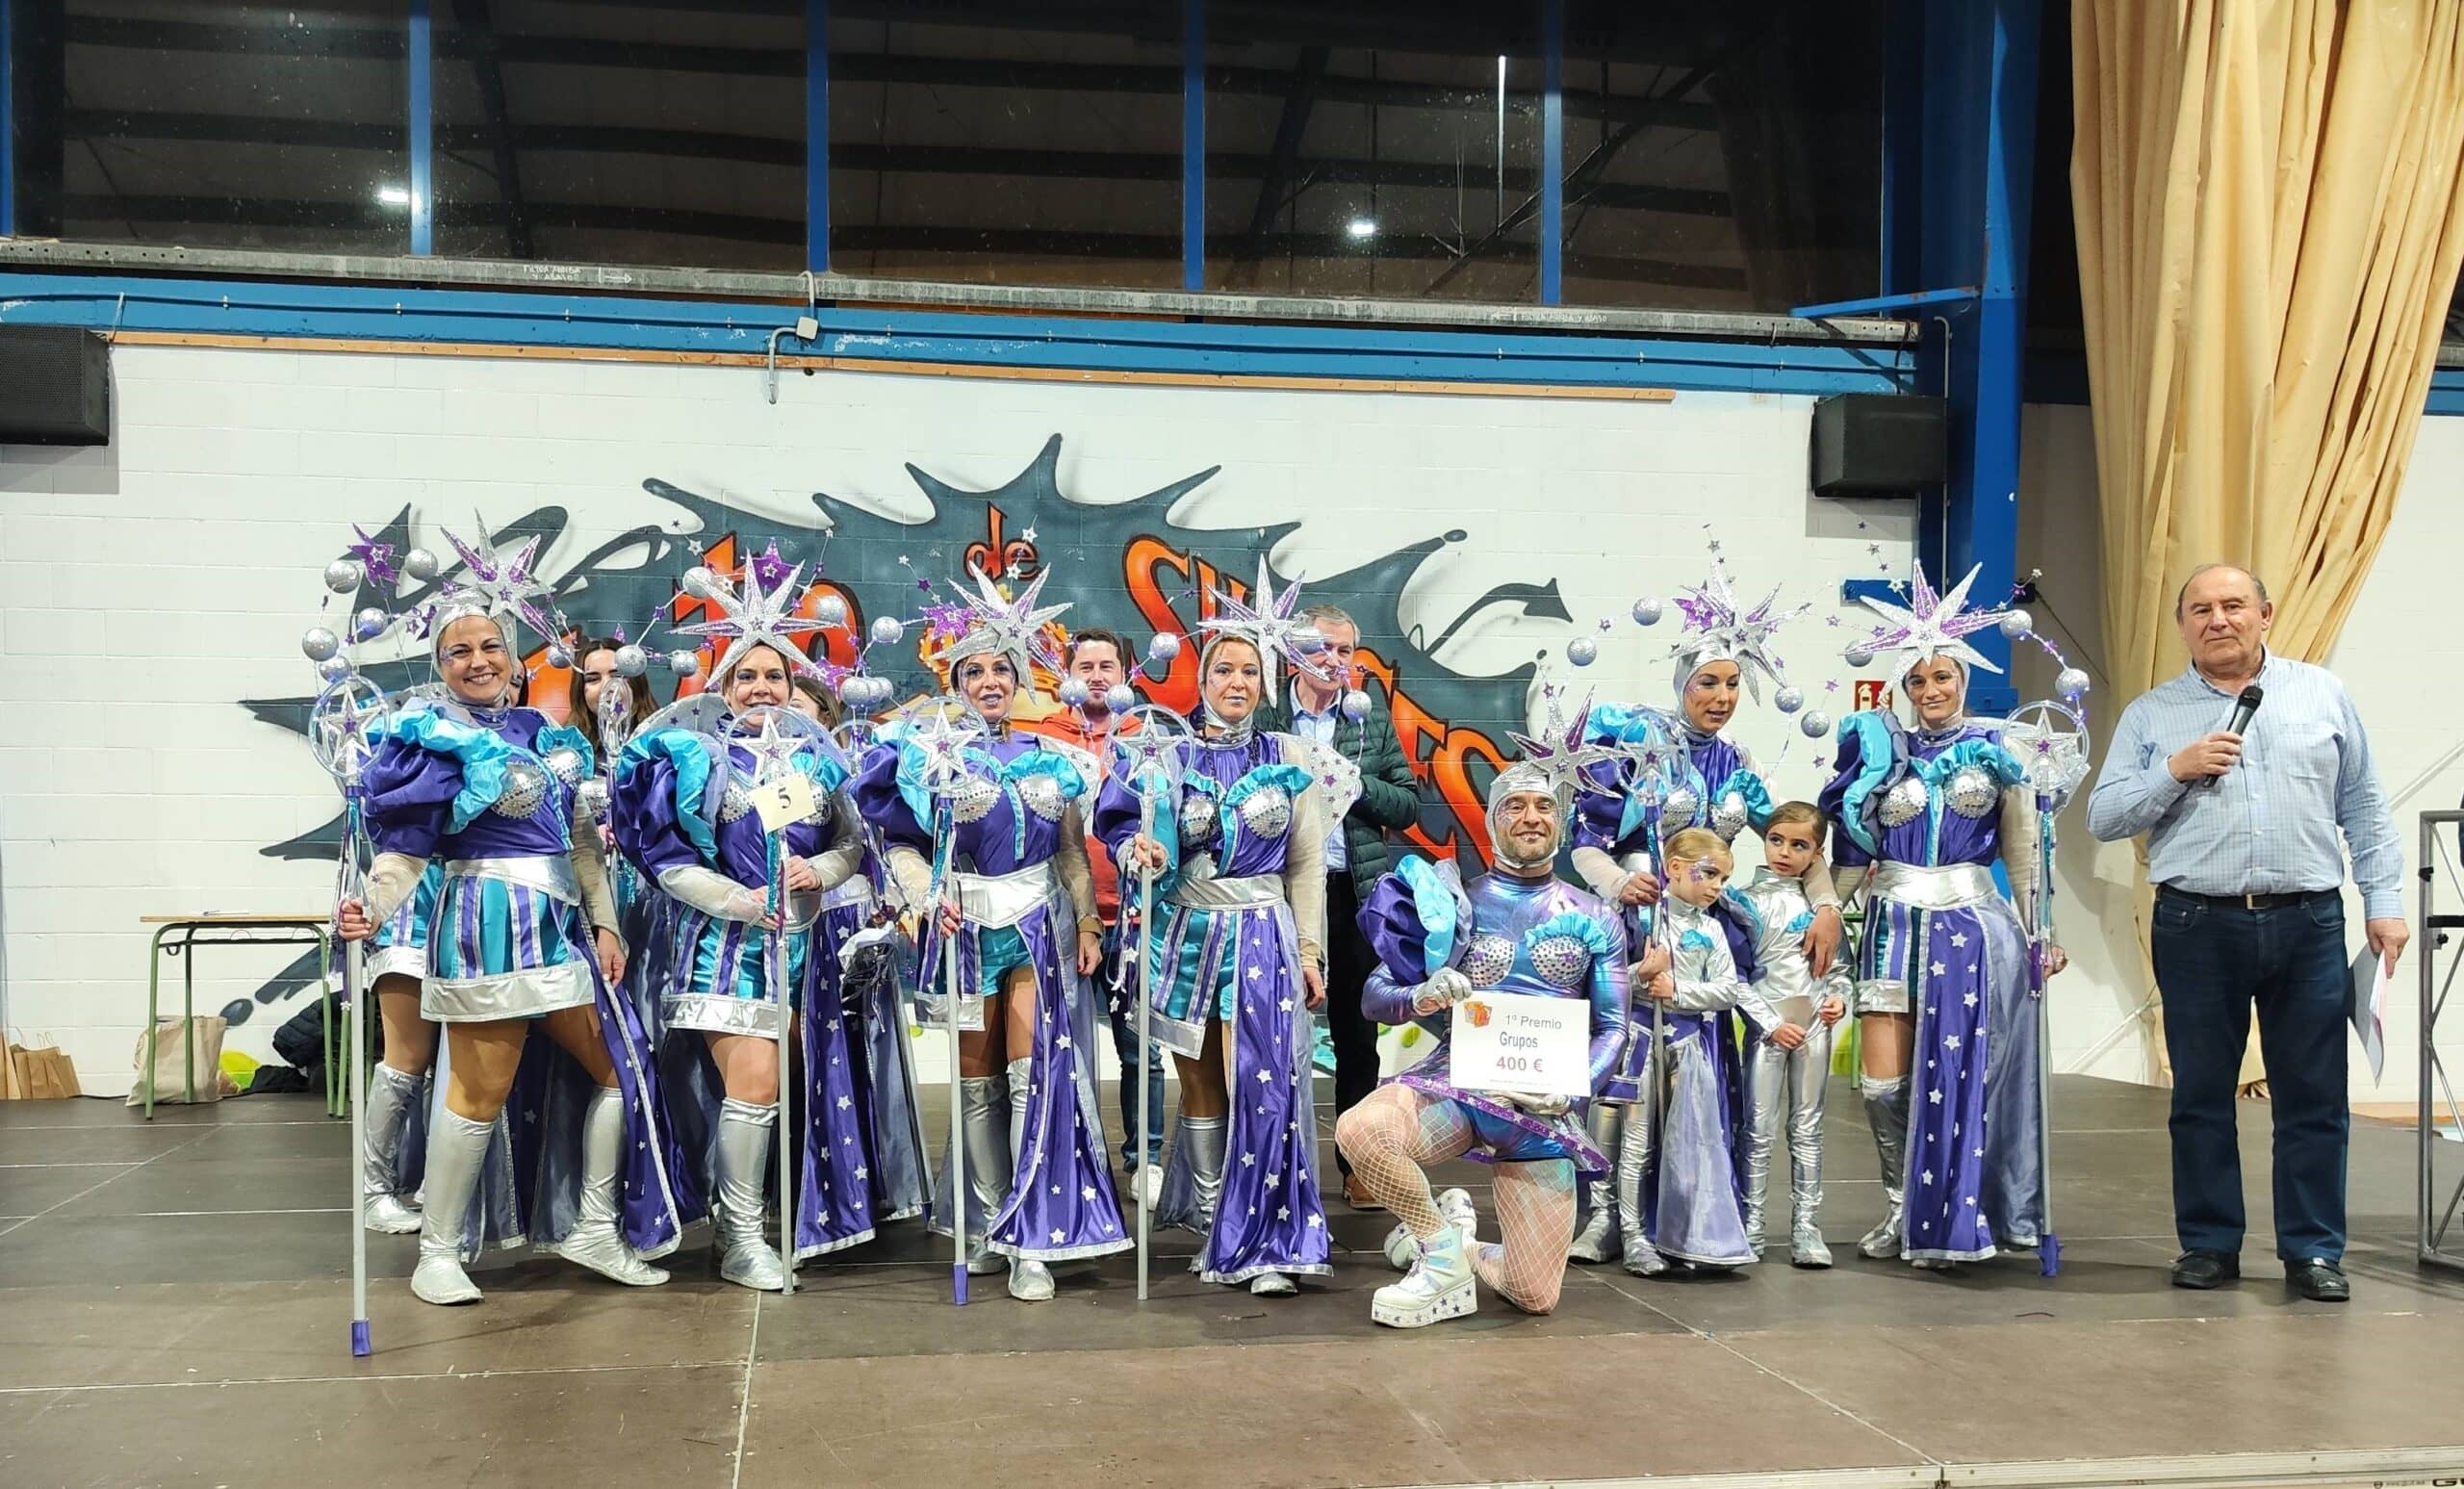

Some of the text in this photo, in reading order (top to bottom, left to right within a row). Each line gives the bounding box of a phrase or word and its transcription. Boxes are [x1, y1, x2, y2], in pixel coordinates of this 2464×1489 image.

[963, 501, 1040, 581] de
[778, 786, 791, 809] 5
[1520, 1015, 1562, 1030] Premio
[1500, 1031, 1538, 1050] Grupos
[1496, 1056, 1544, 1072] 400 €
